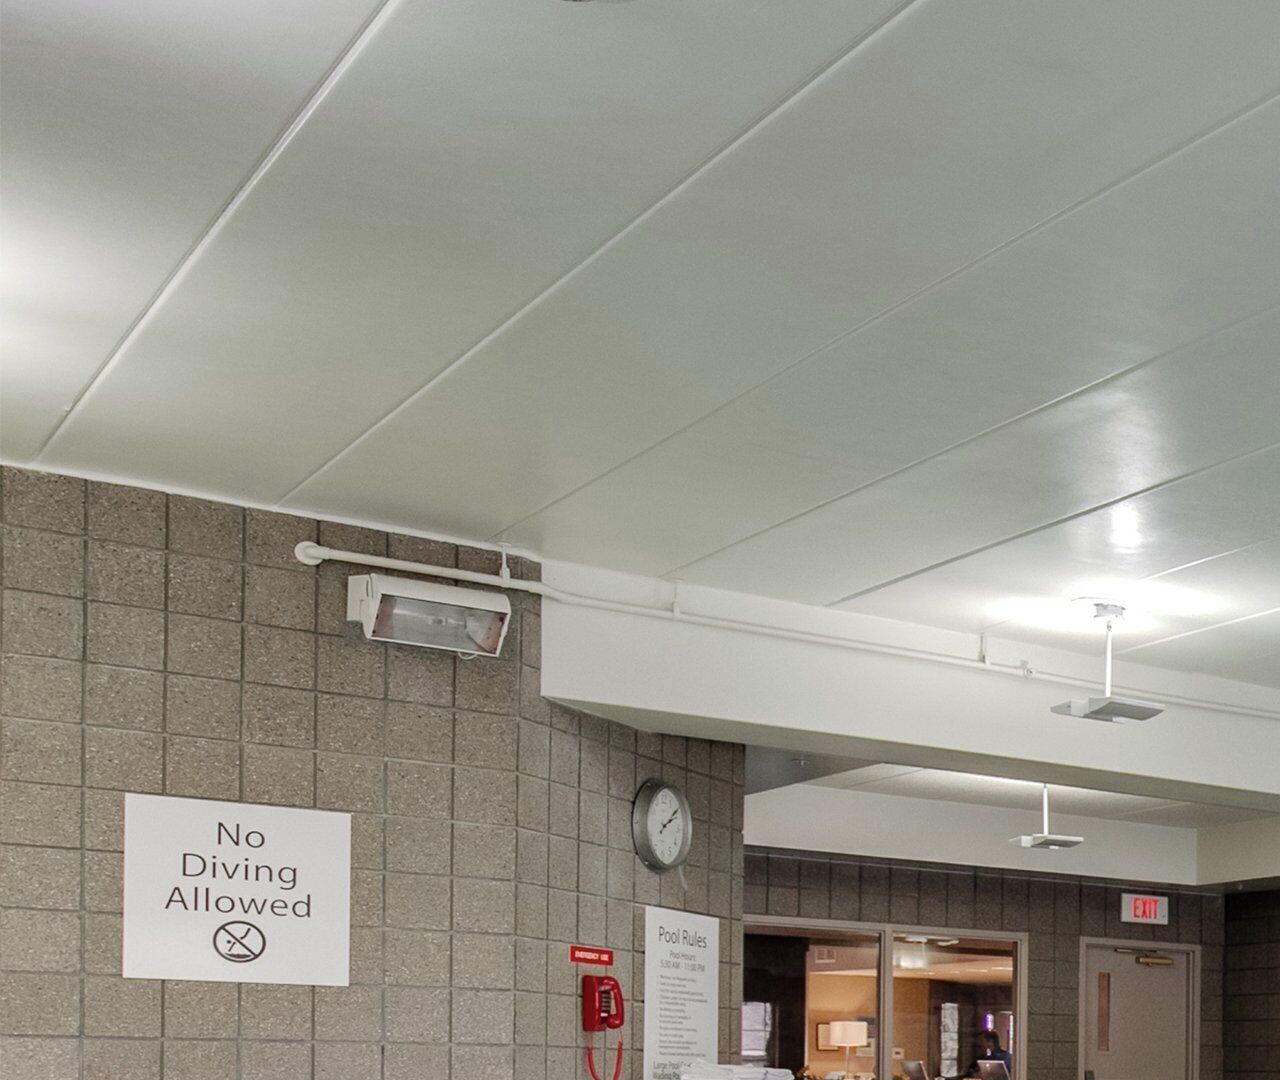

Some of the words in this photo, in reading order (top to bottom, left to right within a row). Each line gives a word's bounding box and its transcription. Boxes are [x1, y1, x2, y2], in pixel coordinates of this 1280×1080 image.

[217, 822, 265, 848] No
[182, 853, 297, 890] Diving
[165, 886, 311, 918] Allowed
[1133, 897, 1159, 919] EXIT
[659, 926, 680, 944] Pool
[682, 929, 707, 948] Rules
